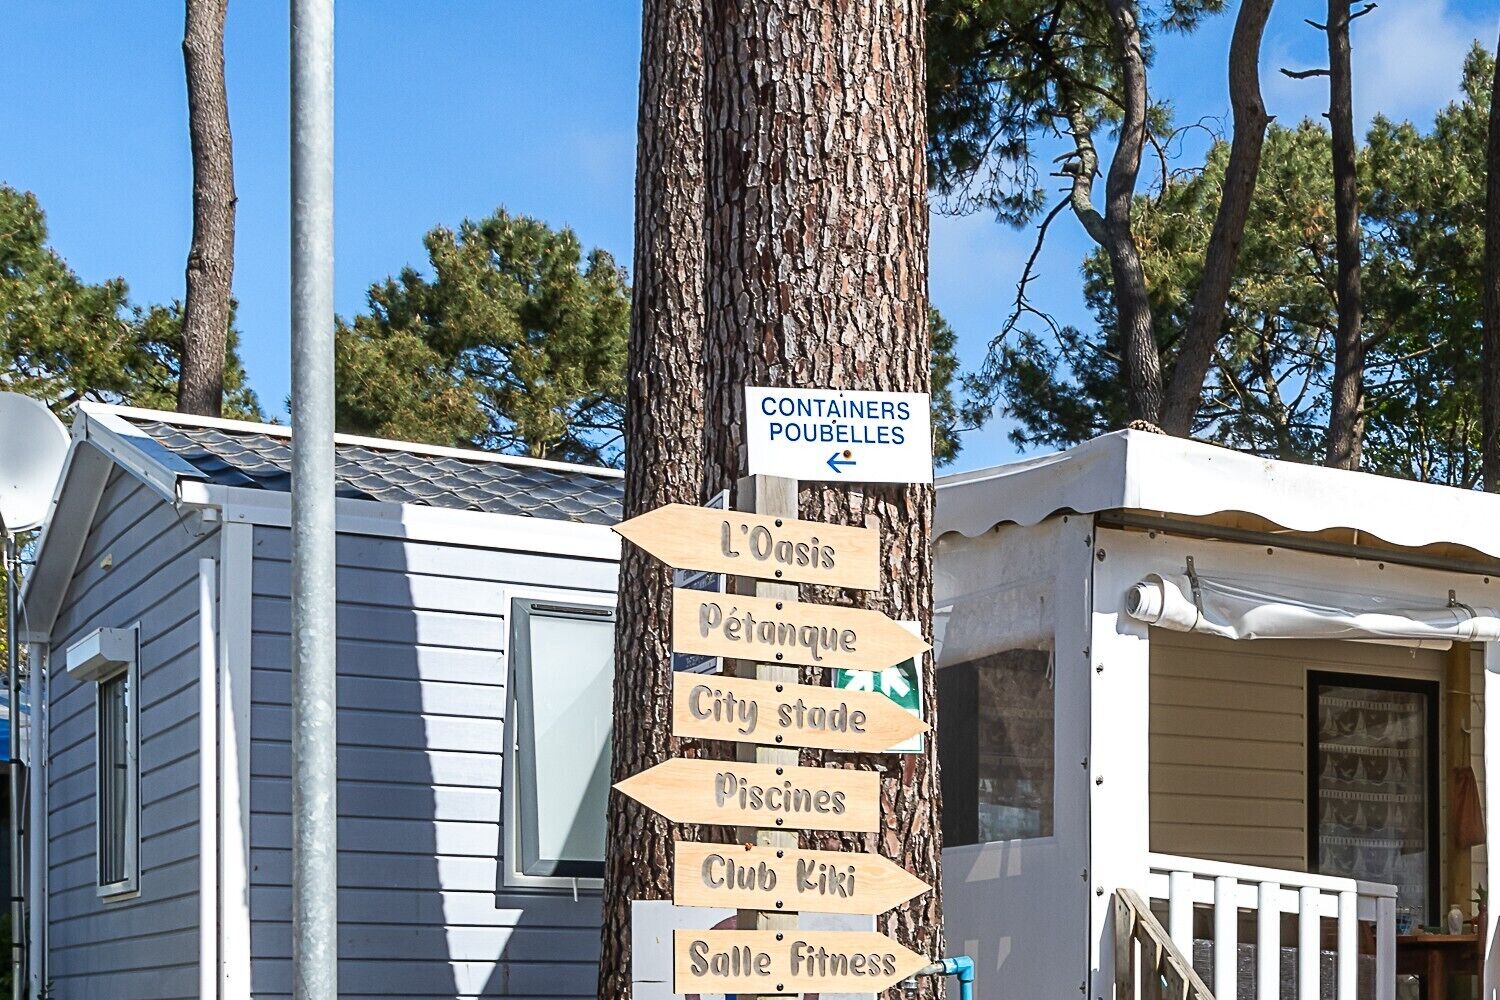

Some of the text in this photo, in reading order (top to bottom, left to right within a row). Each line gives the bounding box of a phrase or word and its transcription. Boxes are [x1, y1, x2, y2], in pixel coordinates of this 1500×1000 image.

[761, 396, 910, 420] CONTAINERS
[770, 422, 904, 444] POUBELLES
[721, 520, 835, 568] L'Oasis
[699, 602, 857, 661] Pétanque
[689, 684, 866, 735] City stade
[715, 772, 846, 815] Piscines
[702, 854, 856, 898] Club Kiki
[689, 941, 896, 977] Salle Fitness
